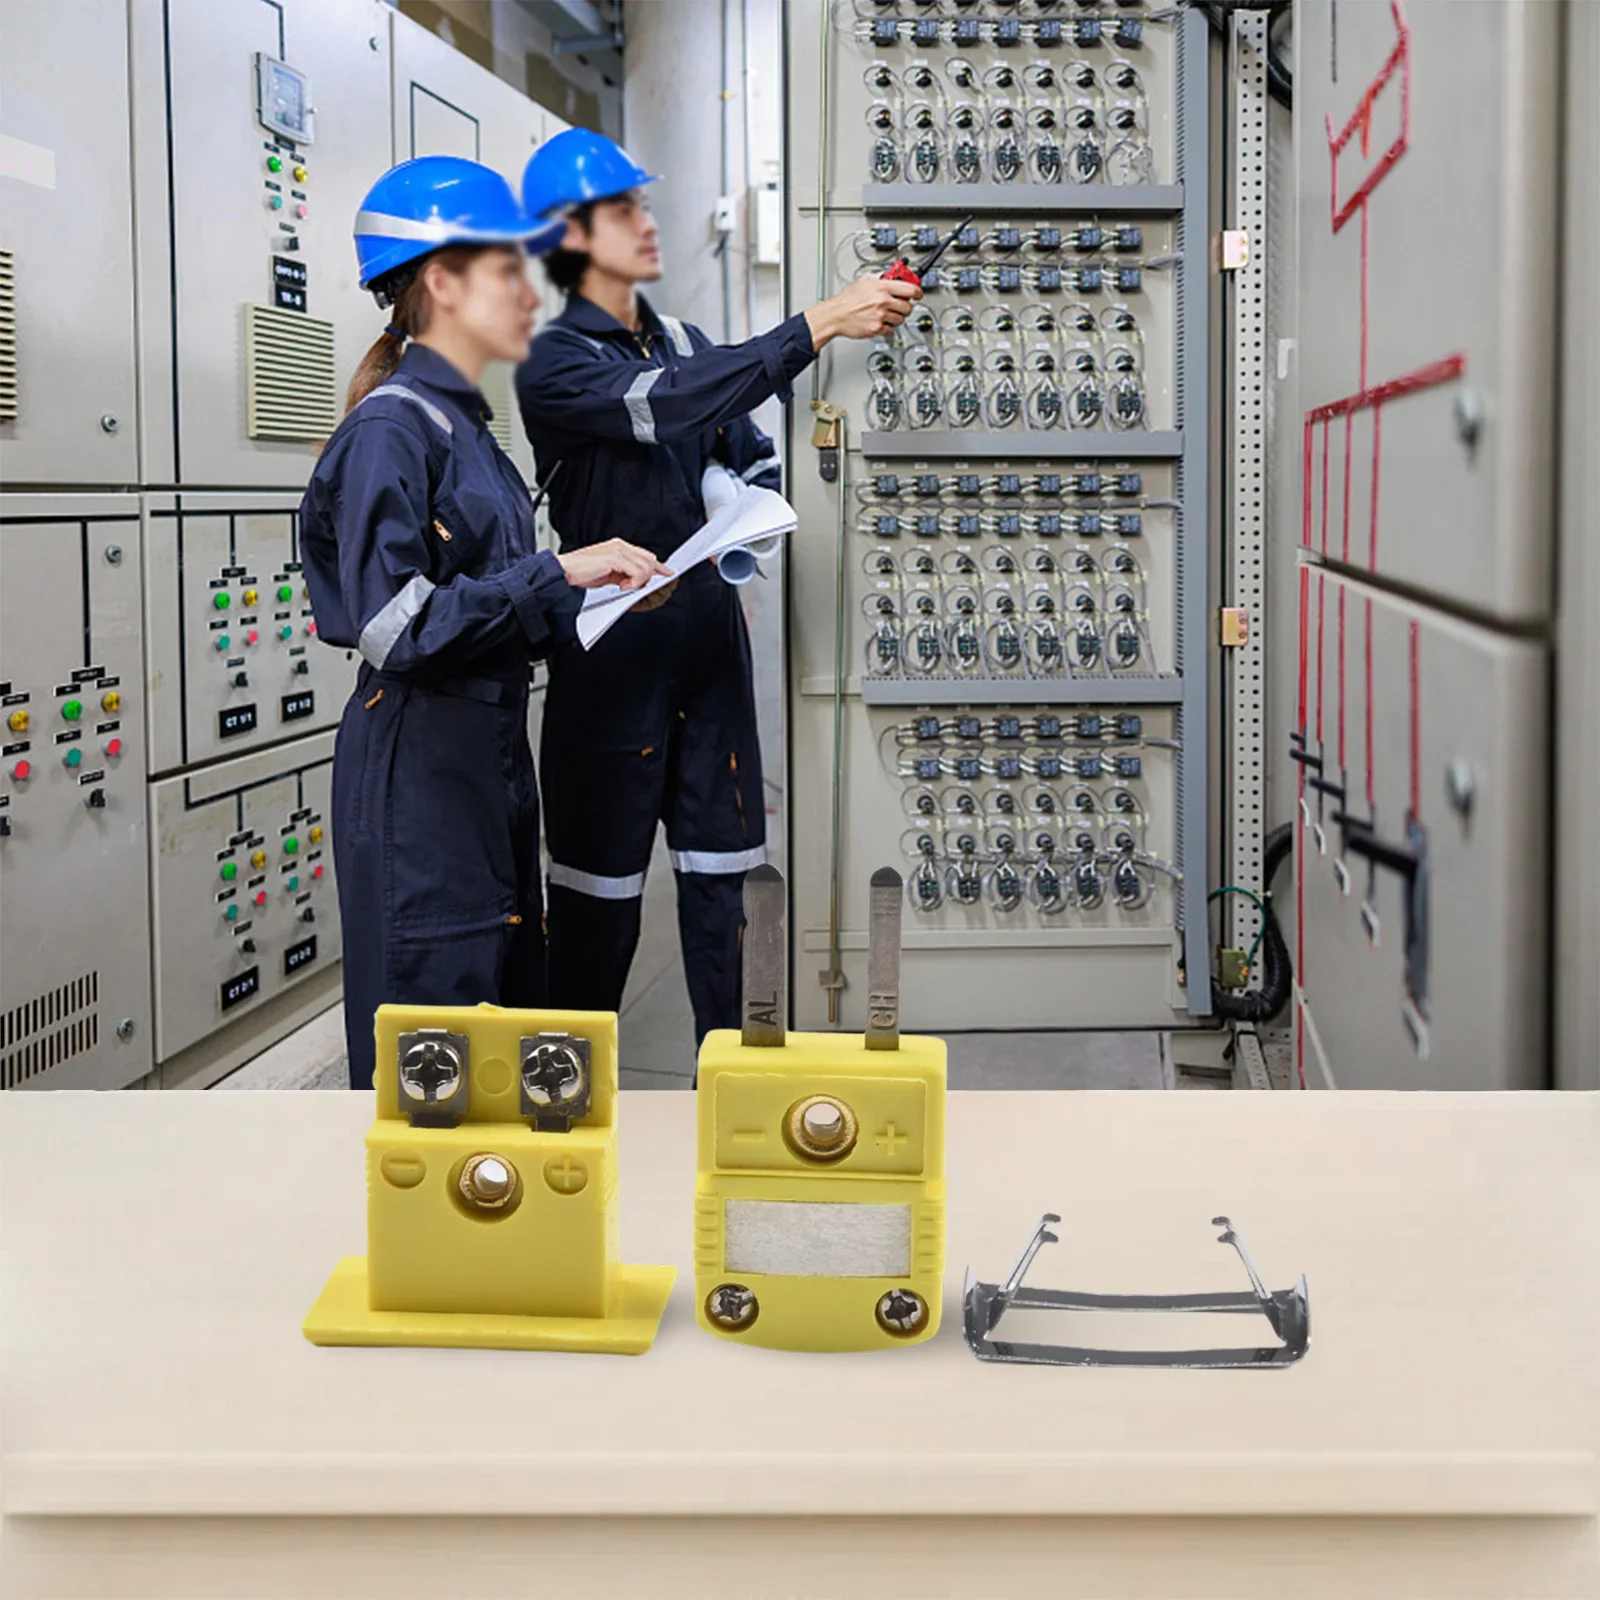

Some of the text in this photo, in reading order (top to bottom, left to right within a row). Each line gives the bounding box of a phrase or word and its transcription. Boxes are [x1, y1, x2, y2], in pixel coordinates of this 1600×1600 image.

[287, 701, 297, 713] CT
[226, 716, 238, 728] CT
[289, 953, 299, 965] CT
[229, 985, 239, 998] CT
[748, 990, 777, 1026] AL
[869, 994, 897, 1031] CH
